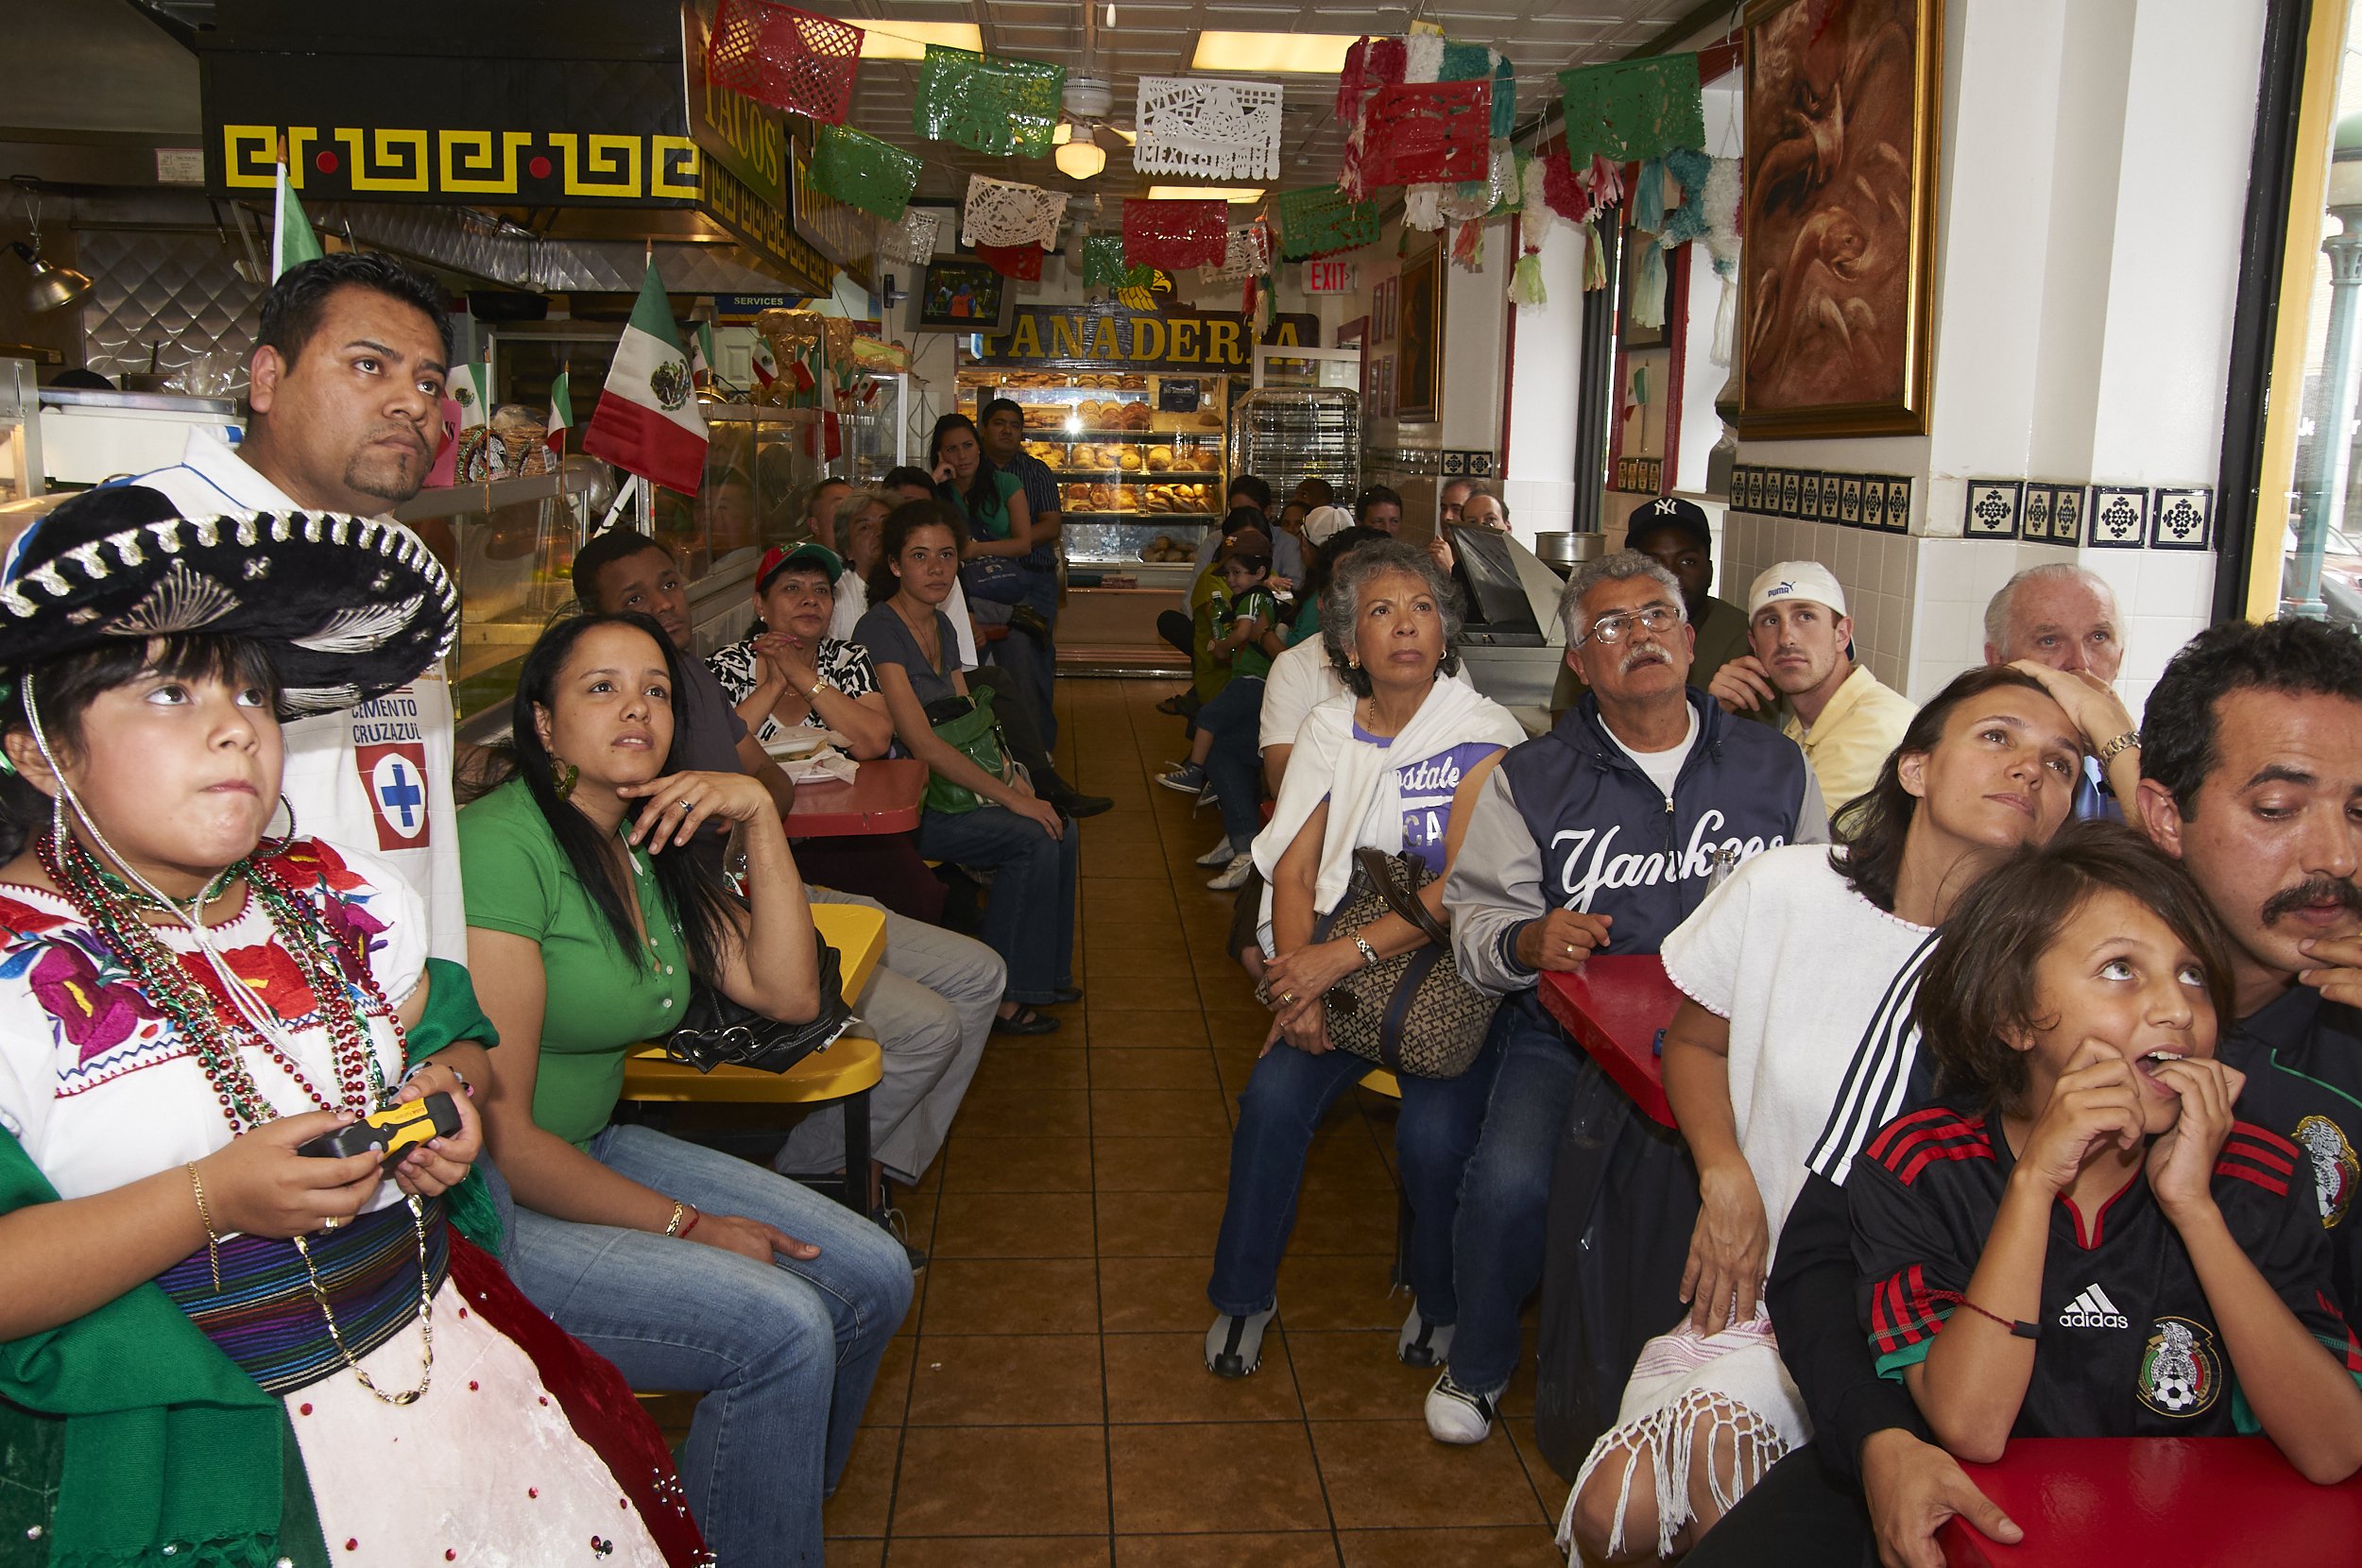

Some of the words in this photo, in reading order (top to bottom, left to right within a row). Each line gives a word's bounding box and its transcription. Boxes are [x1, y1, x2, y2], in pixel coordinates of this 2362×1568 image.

[1311, 263, 1345, 290] EXIT
[734, 297, 783, 305] SERVICES
[983, 314, 1306, 366] ANADERA
[1654, 498, 1677, 516] NY
[1768, 587, 1789, 597] PUMA
[2059, 1311, 2130, 1329] adidas
